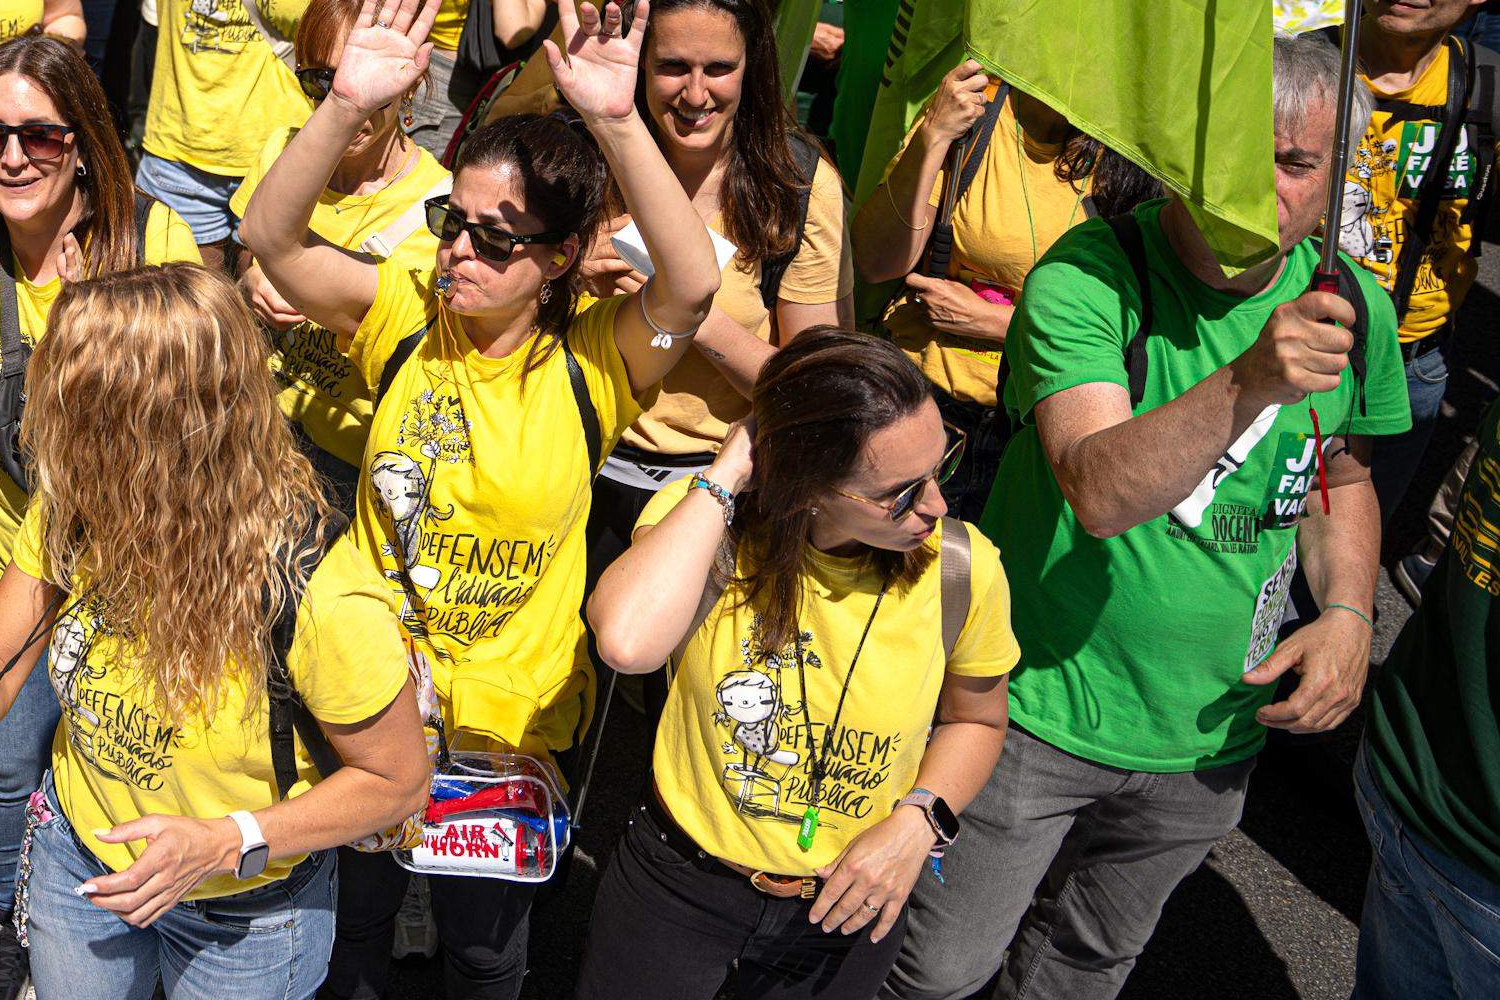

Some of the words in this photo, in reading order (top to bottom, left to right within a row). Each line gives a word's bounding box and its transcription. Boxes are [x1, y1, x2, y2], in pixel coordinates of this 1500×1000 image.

[420, 533, 547, 581] DEFENSEM
[79, 688, 174, 754] DEFENSEM
[780, 721, 892, 766] DEFENSEM
[432, 841, 500, 859] HORN
[445, 824, 488, 842] AIR
